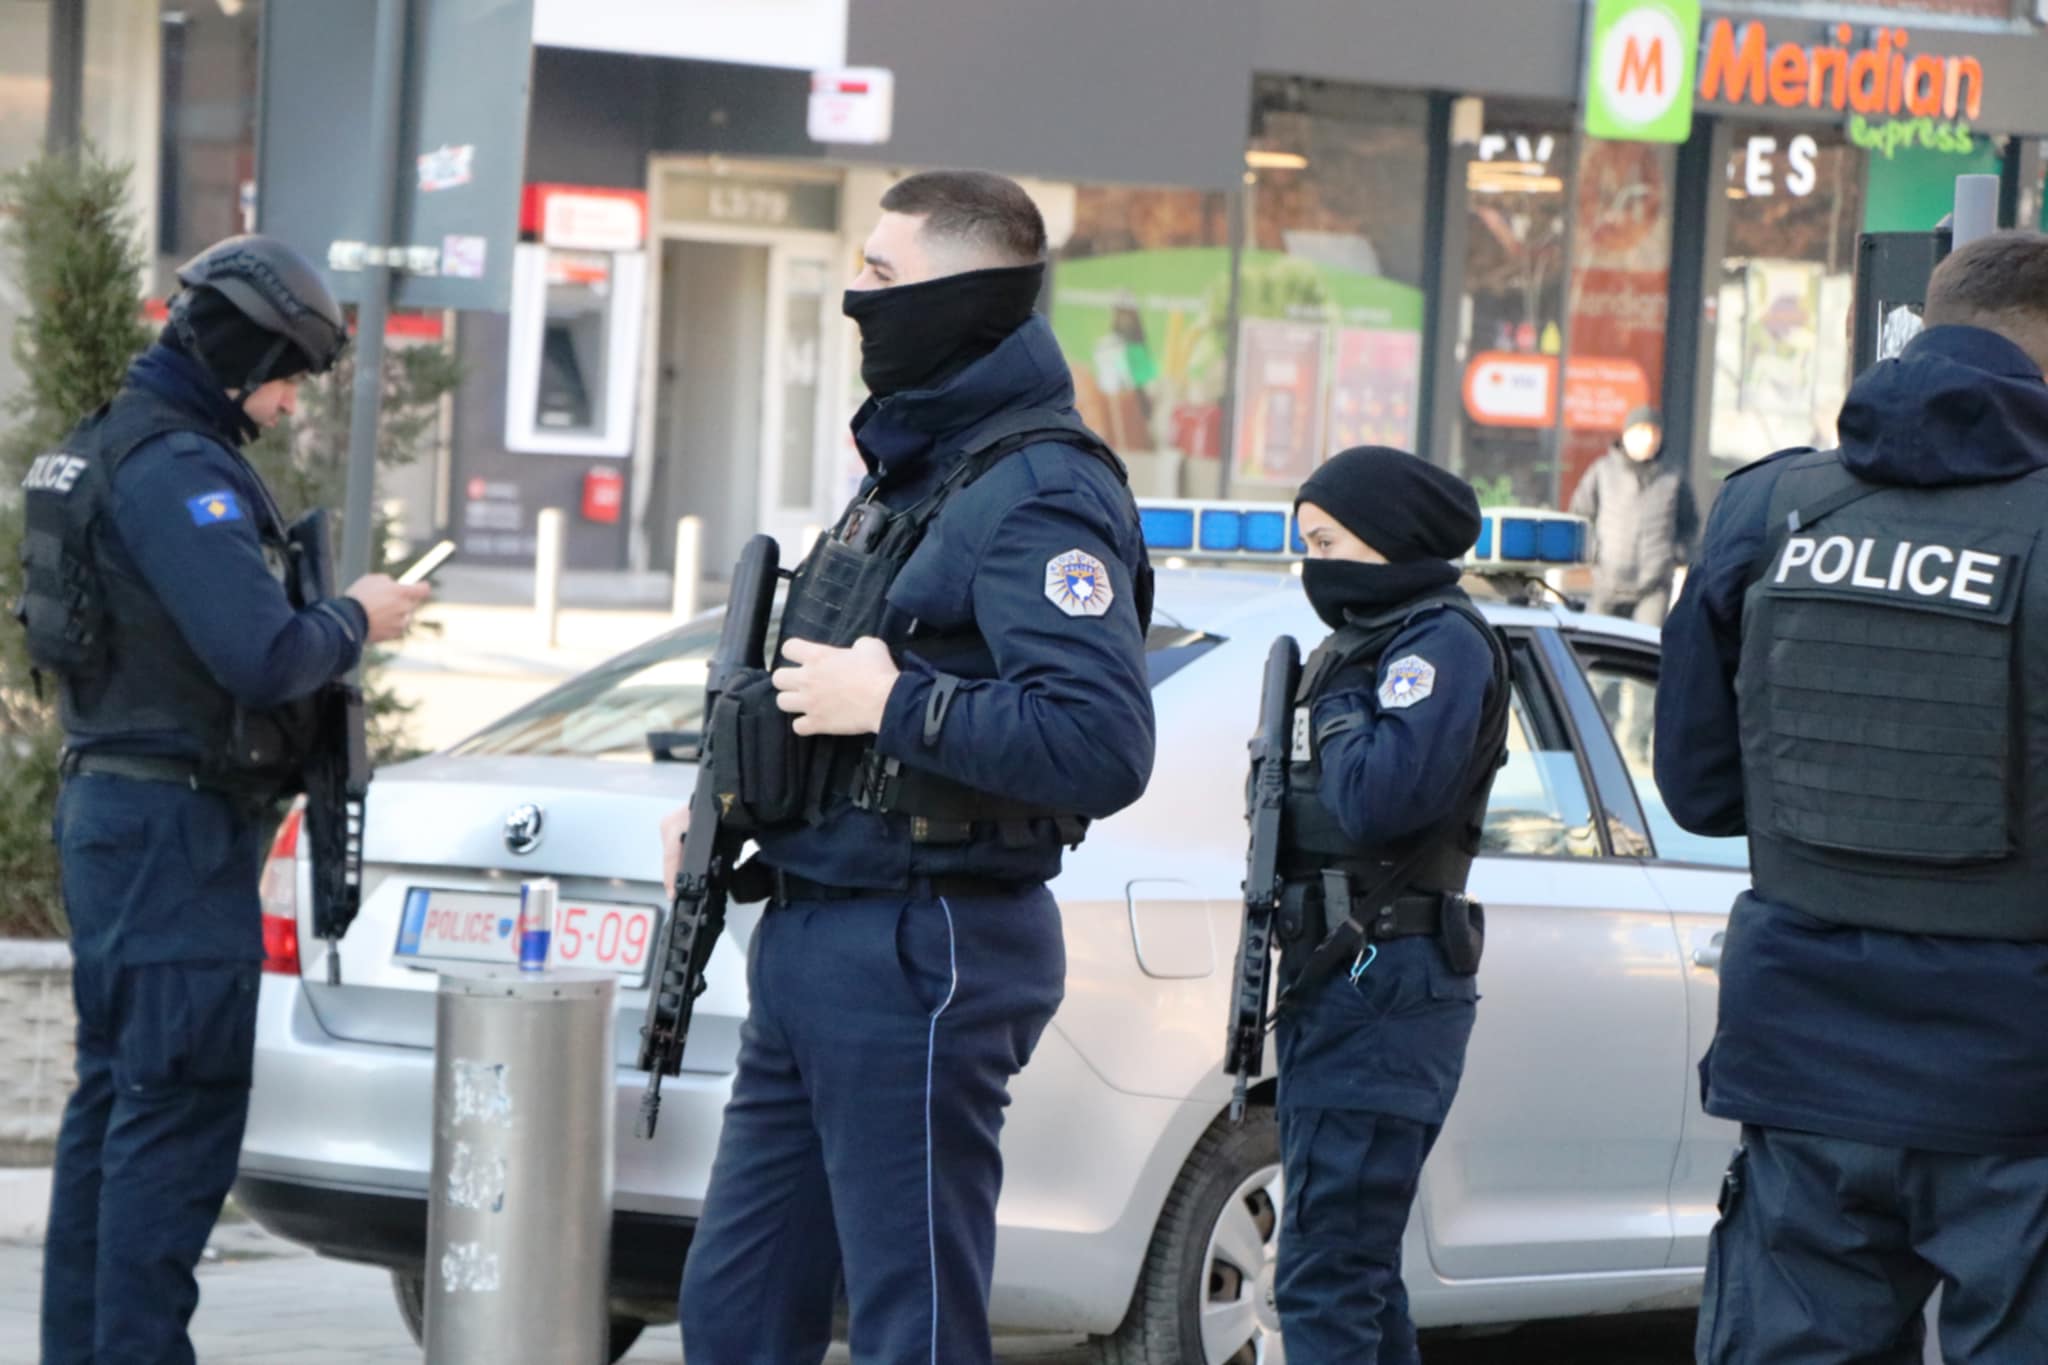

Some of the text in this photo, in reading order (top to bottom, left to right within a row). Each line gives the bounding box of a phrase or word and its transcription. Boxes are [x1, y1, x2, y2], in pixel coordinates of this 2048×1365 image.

[1617, 34, 1664, 95] M
[1700, 17, 1983, 120] Meridian
[1726, 134, 1818, 195] ES
[1850, 113, 1974, 160] express
[1774, 535, 2001, 606] POLICE
[424, 909, 495, 944] POLICE
